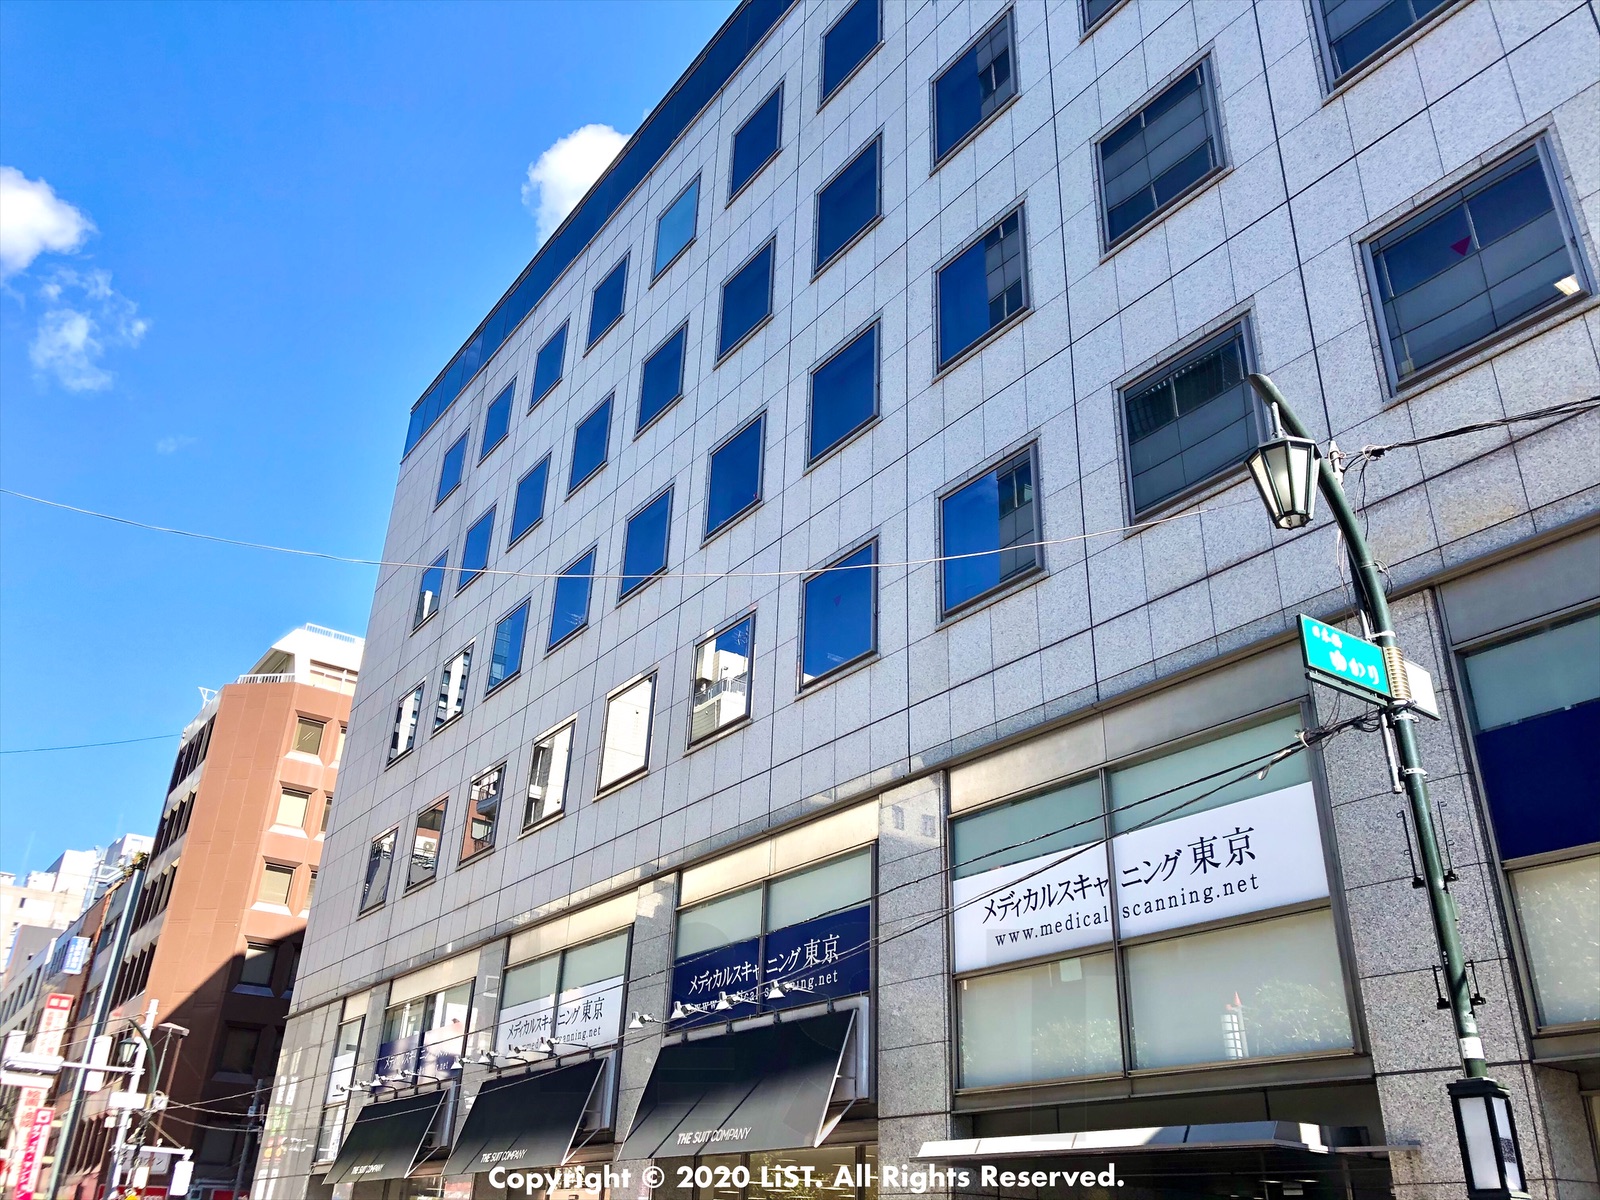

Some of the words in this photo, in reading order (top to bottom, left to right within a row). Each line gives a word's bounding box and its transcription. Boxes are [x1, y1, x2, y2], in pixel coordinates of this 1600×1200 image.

[677, 1132, 693, 1145] THE
[692, 1130, 712, 1144] SUIT
[711, 1127, 752, 1142] COMPANY
[480, 1153, 493, 1163] THE
[492, 1151, 503, 1162] SUIT
[502, 1149, 528, 1161] COMPANY
